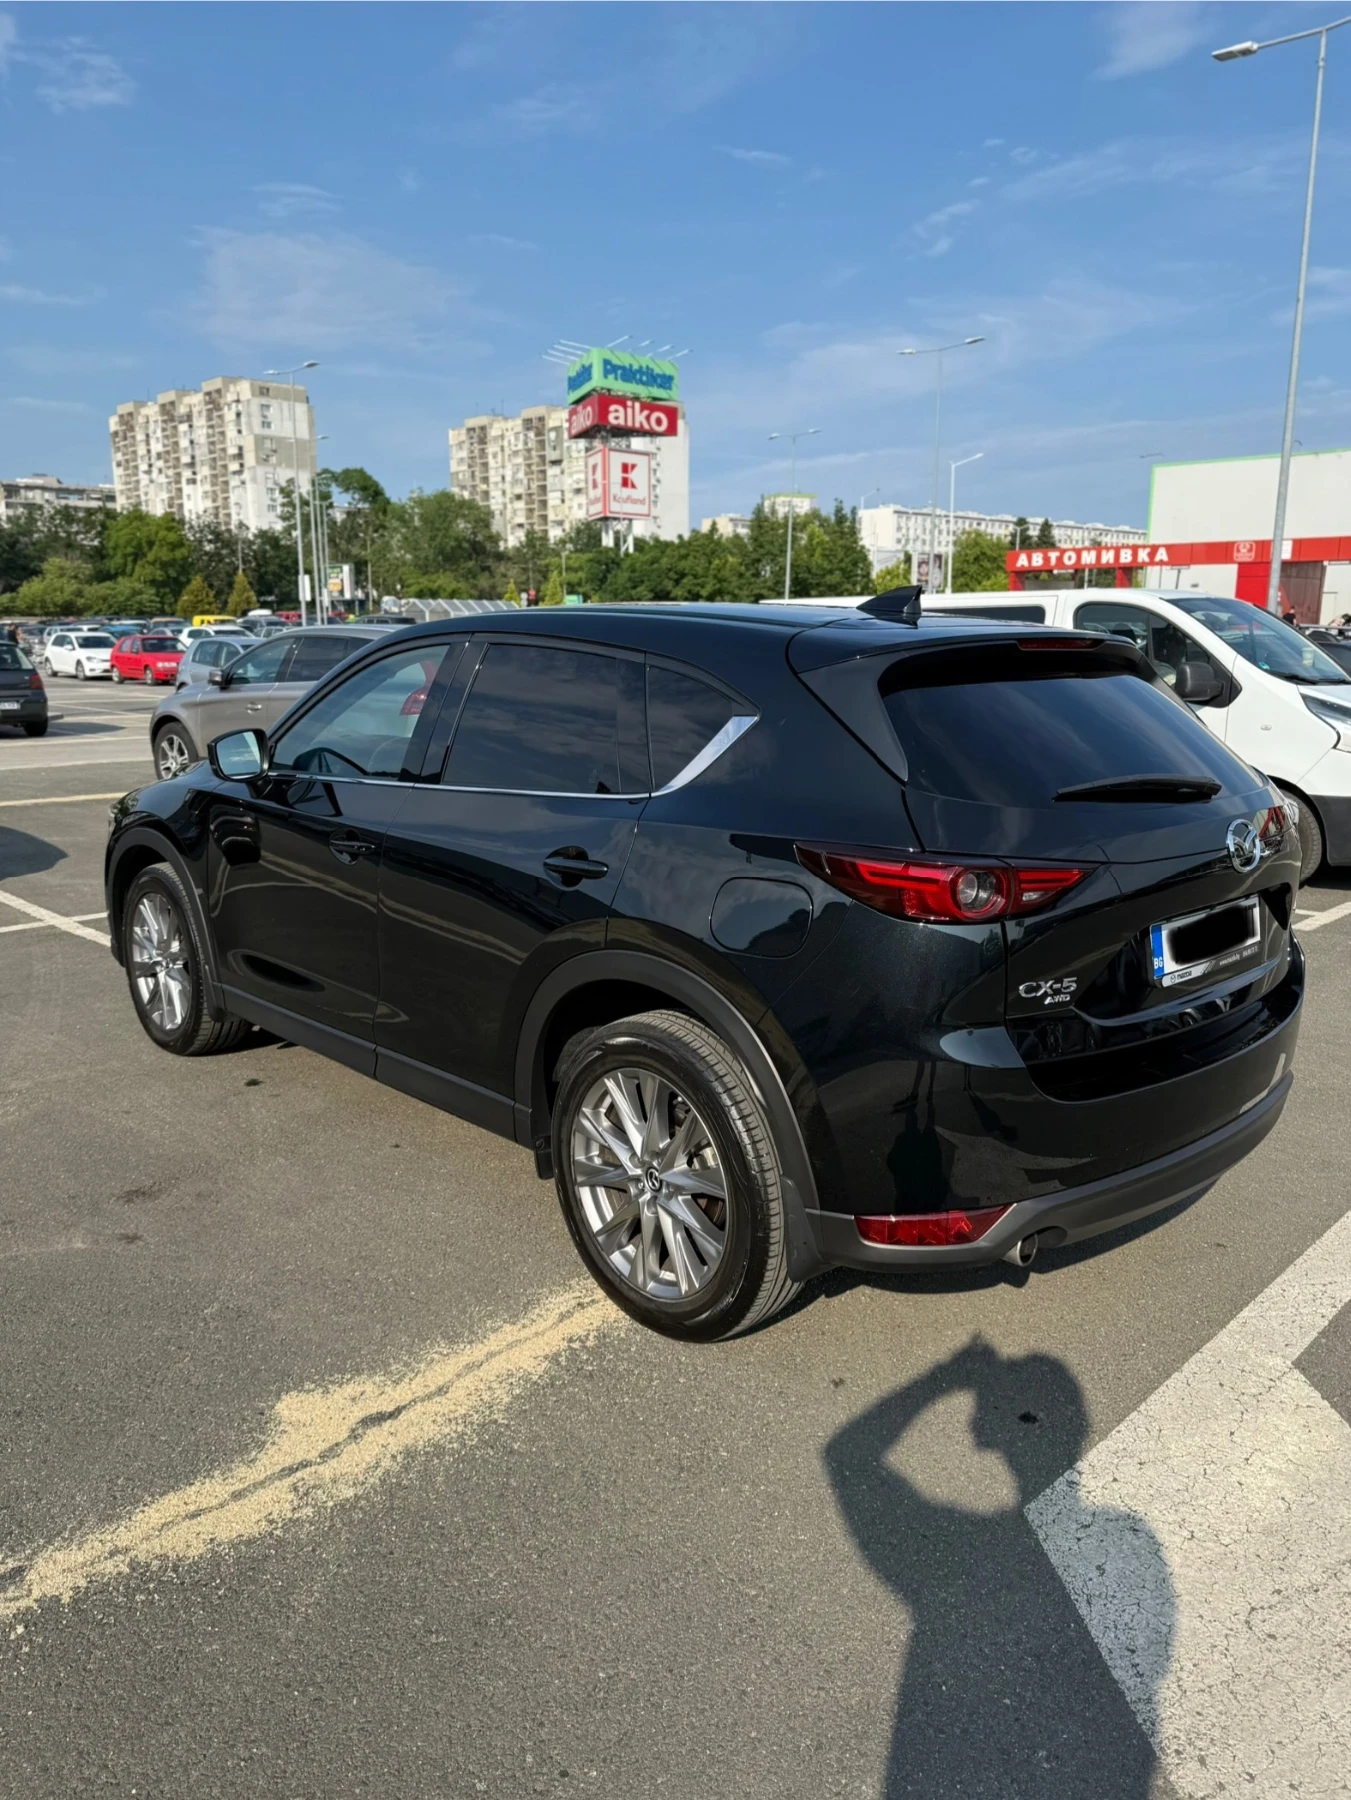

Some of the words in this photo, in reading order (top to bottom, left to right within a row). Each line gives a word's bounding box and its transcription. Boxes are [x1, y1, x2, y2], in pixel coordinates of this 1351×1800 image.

[571, 404, 593, 436] aiko
[607, 400, 668, 433] aiko
[1015, 547, 1169, 567] АВТОМИВКА
[1153, 957, 1164, 969] BG
[1018, 977, 1077, 998] CX-5
[1043, 993, 1071, 1005] AWD
